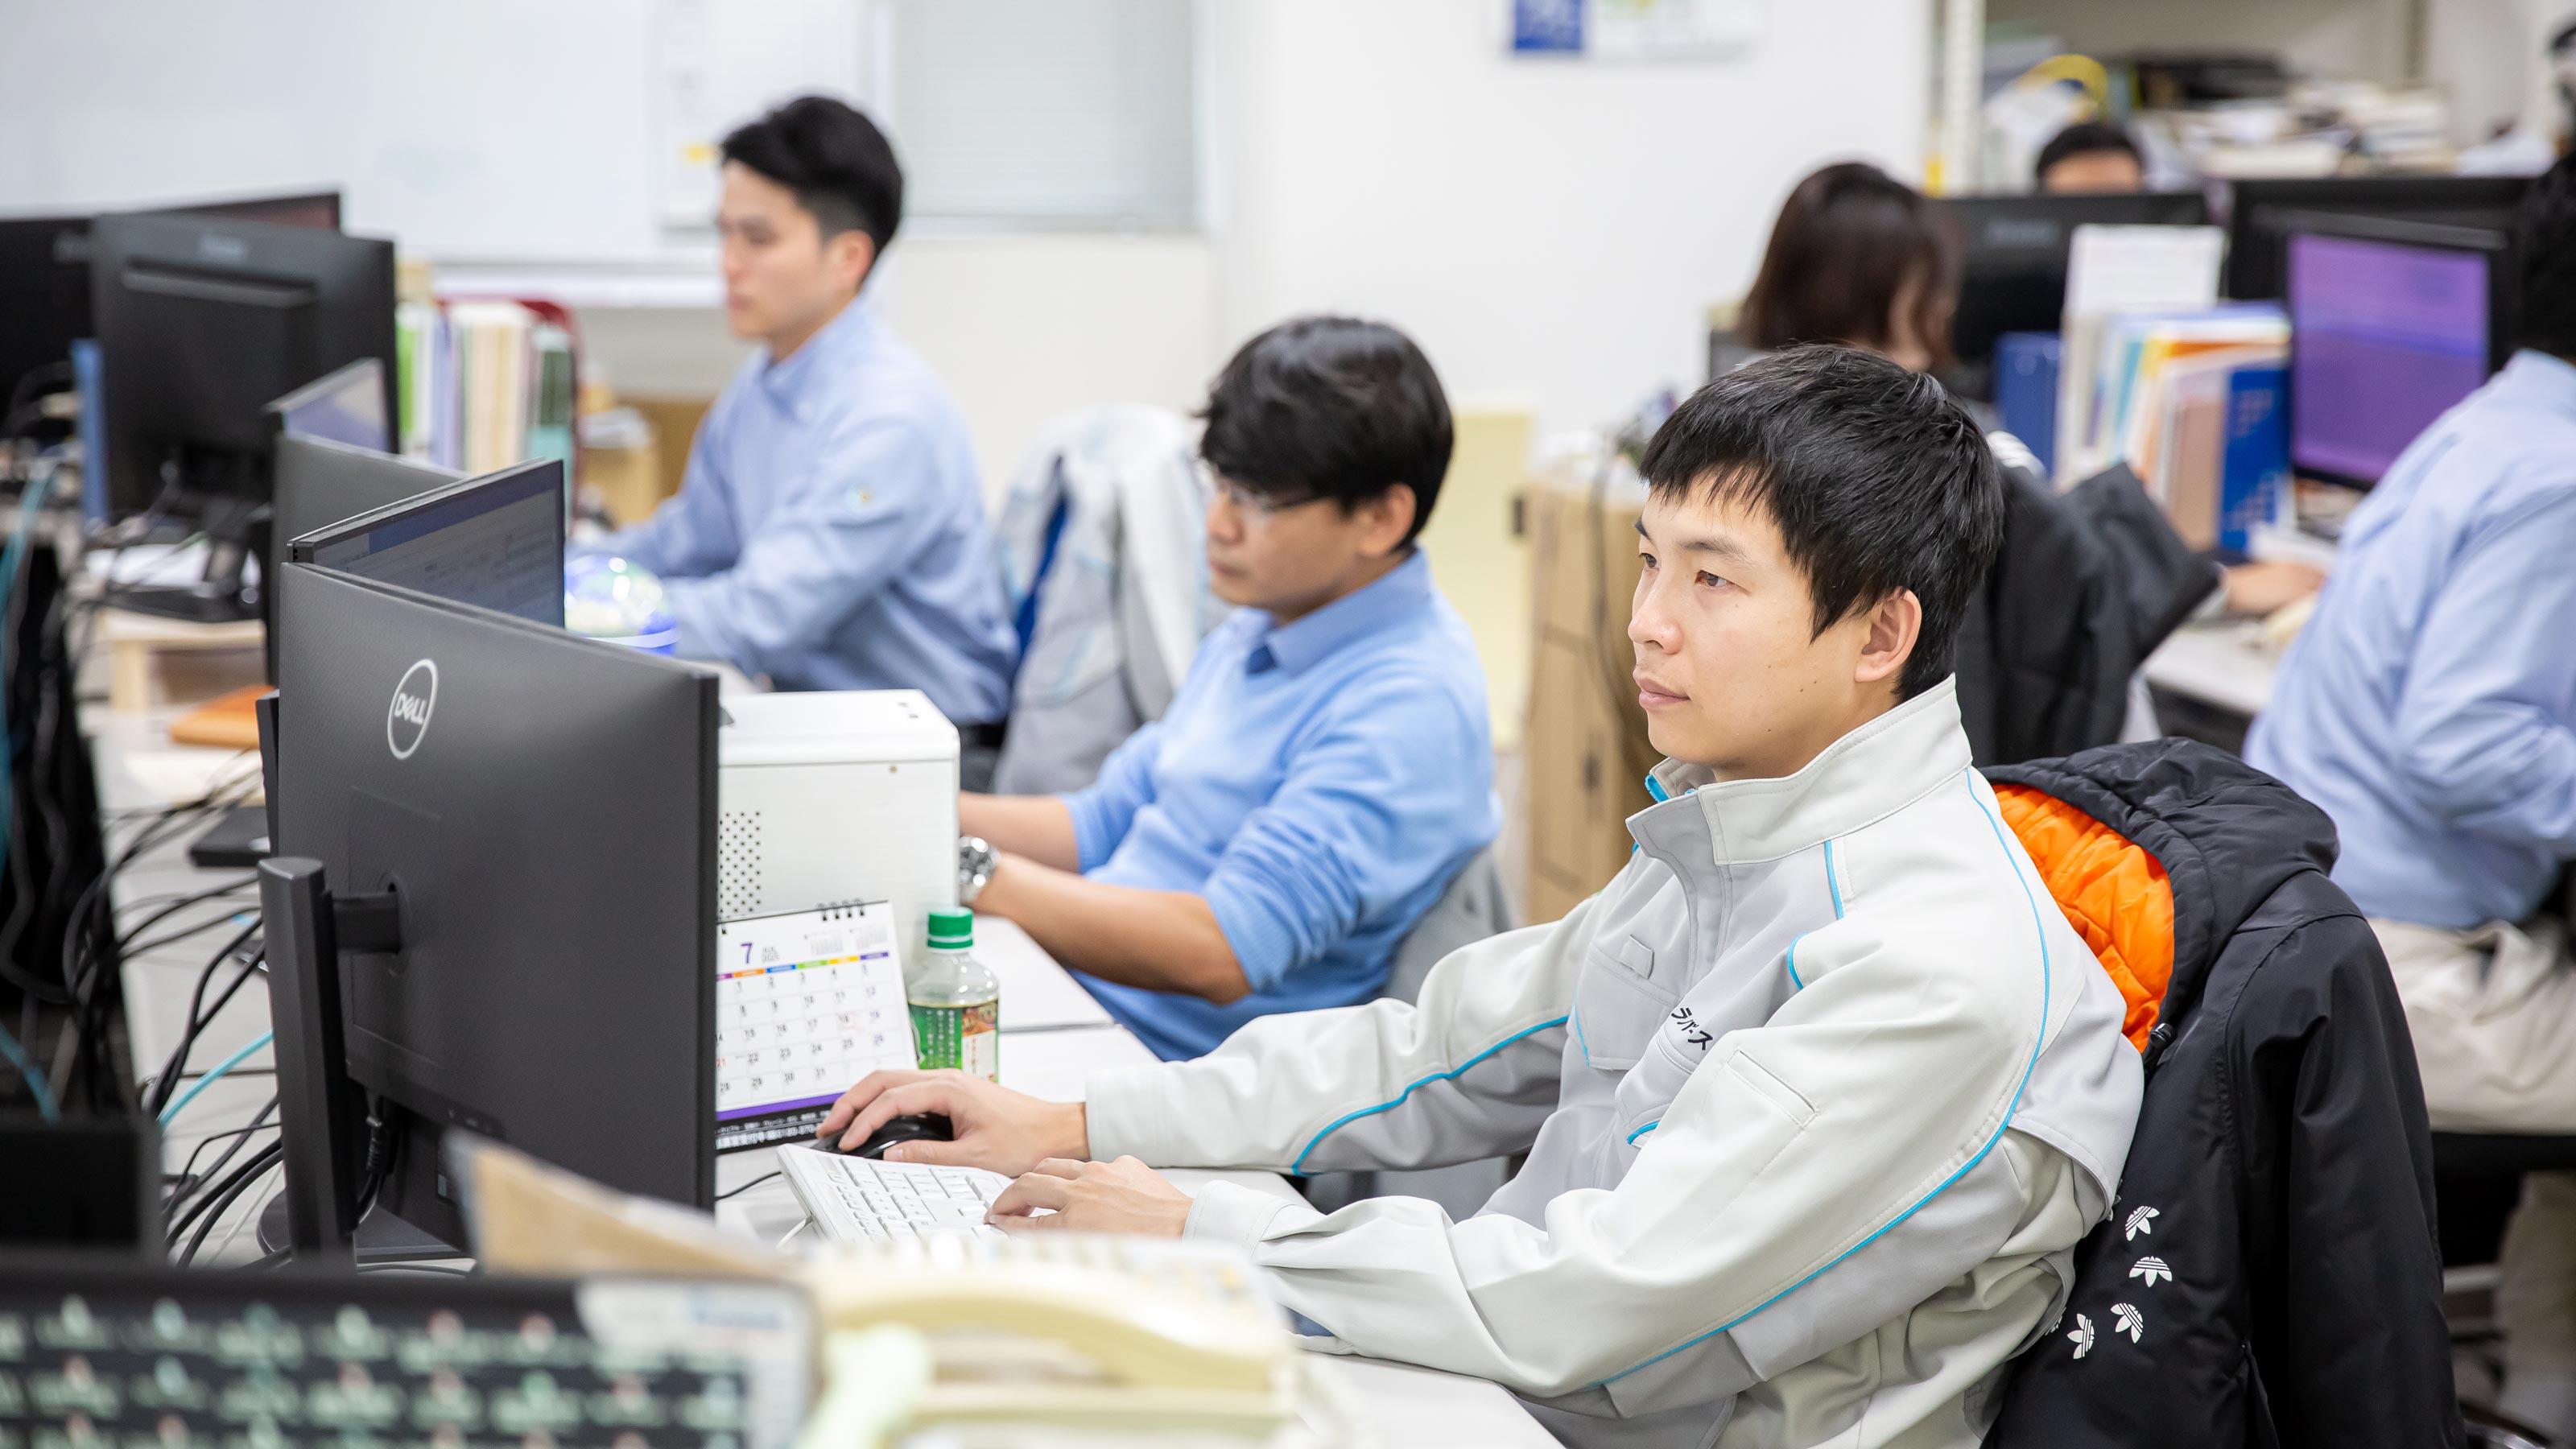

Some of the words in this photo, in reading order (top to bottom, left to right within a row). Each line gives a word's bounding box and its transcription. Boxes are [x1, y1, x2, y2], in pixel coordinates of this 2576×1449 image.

[394, 692, 427, 725] DELL
[740, 941, 753, 964] 7
[747, 1051, 760, 1067] 22
[778, 1046, 792, 1062] 23
